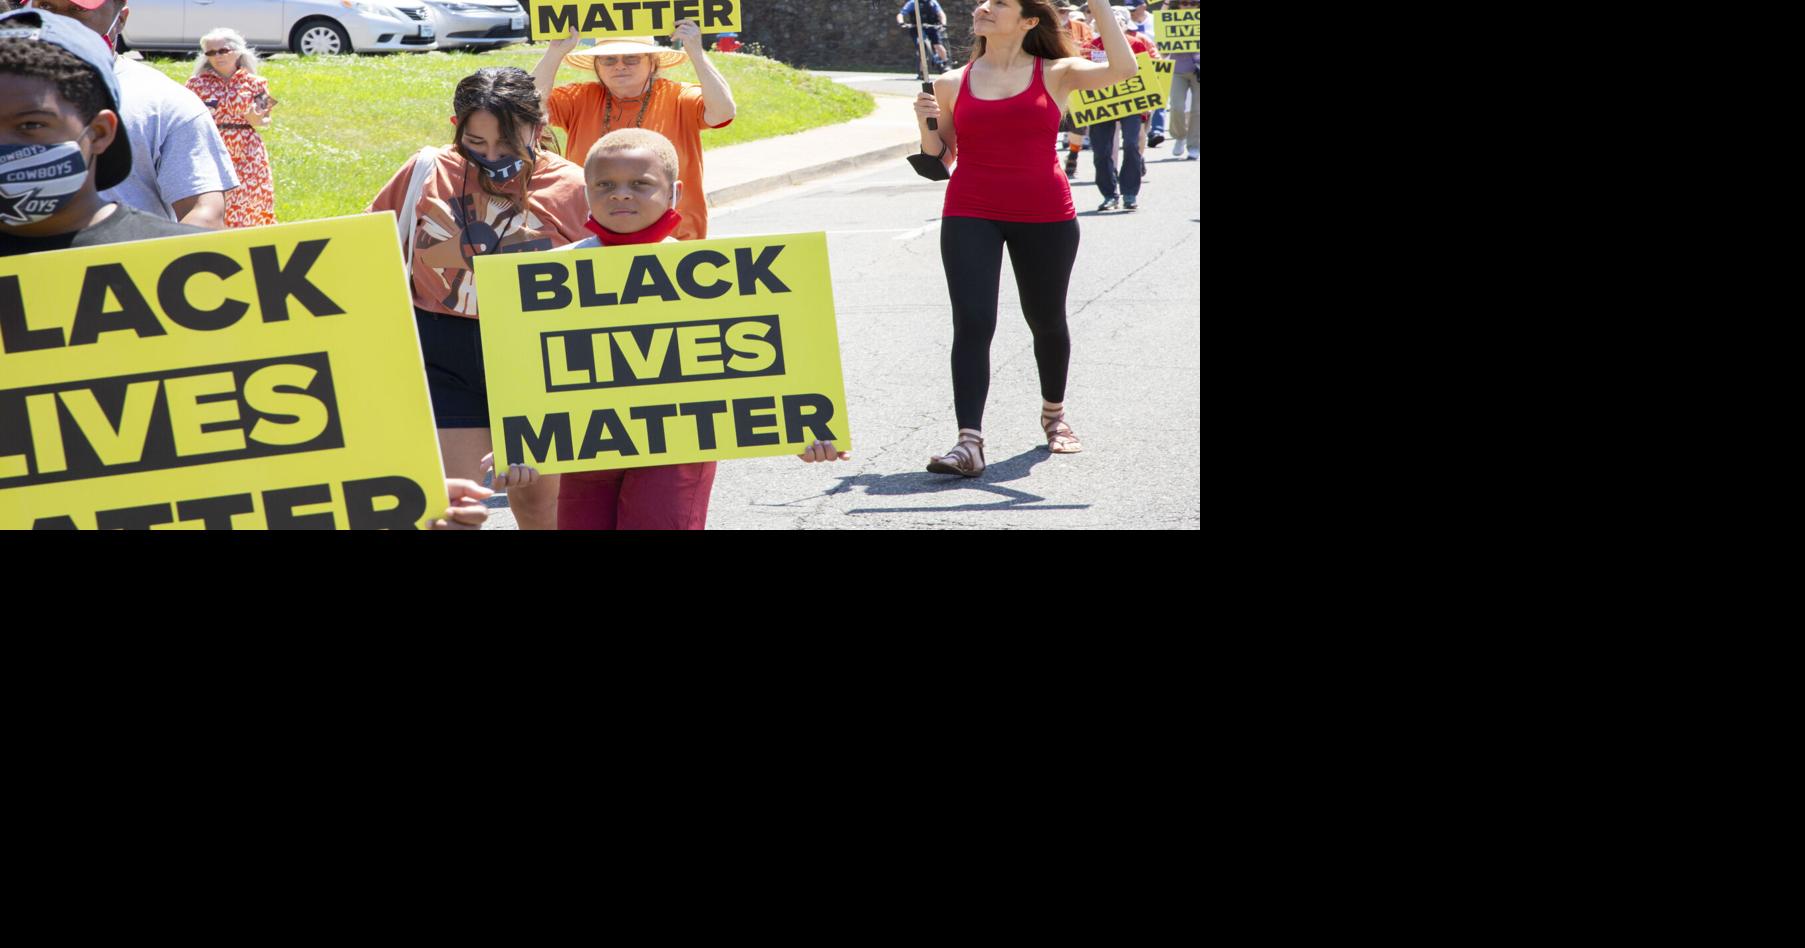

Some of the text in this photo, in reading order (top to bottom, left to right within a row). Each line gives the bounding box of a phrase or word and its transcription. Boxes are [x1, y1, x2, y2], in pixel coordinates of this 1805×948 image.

[538, 0, 733, 33] MATTER
[1081, 77, 1143, 103] LIVES
[1075, 93, 1162, 124] MATTER
[7, 161, 72, 181] COWBOYS
[517, 245, 791, 312] BLACK
[546, 321, 776, 386] LIVES
[502, 393, 836, 465] MATTER
